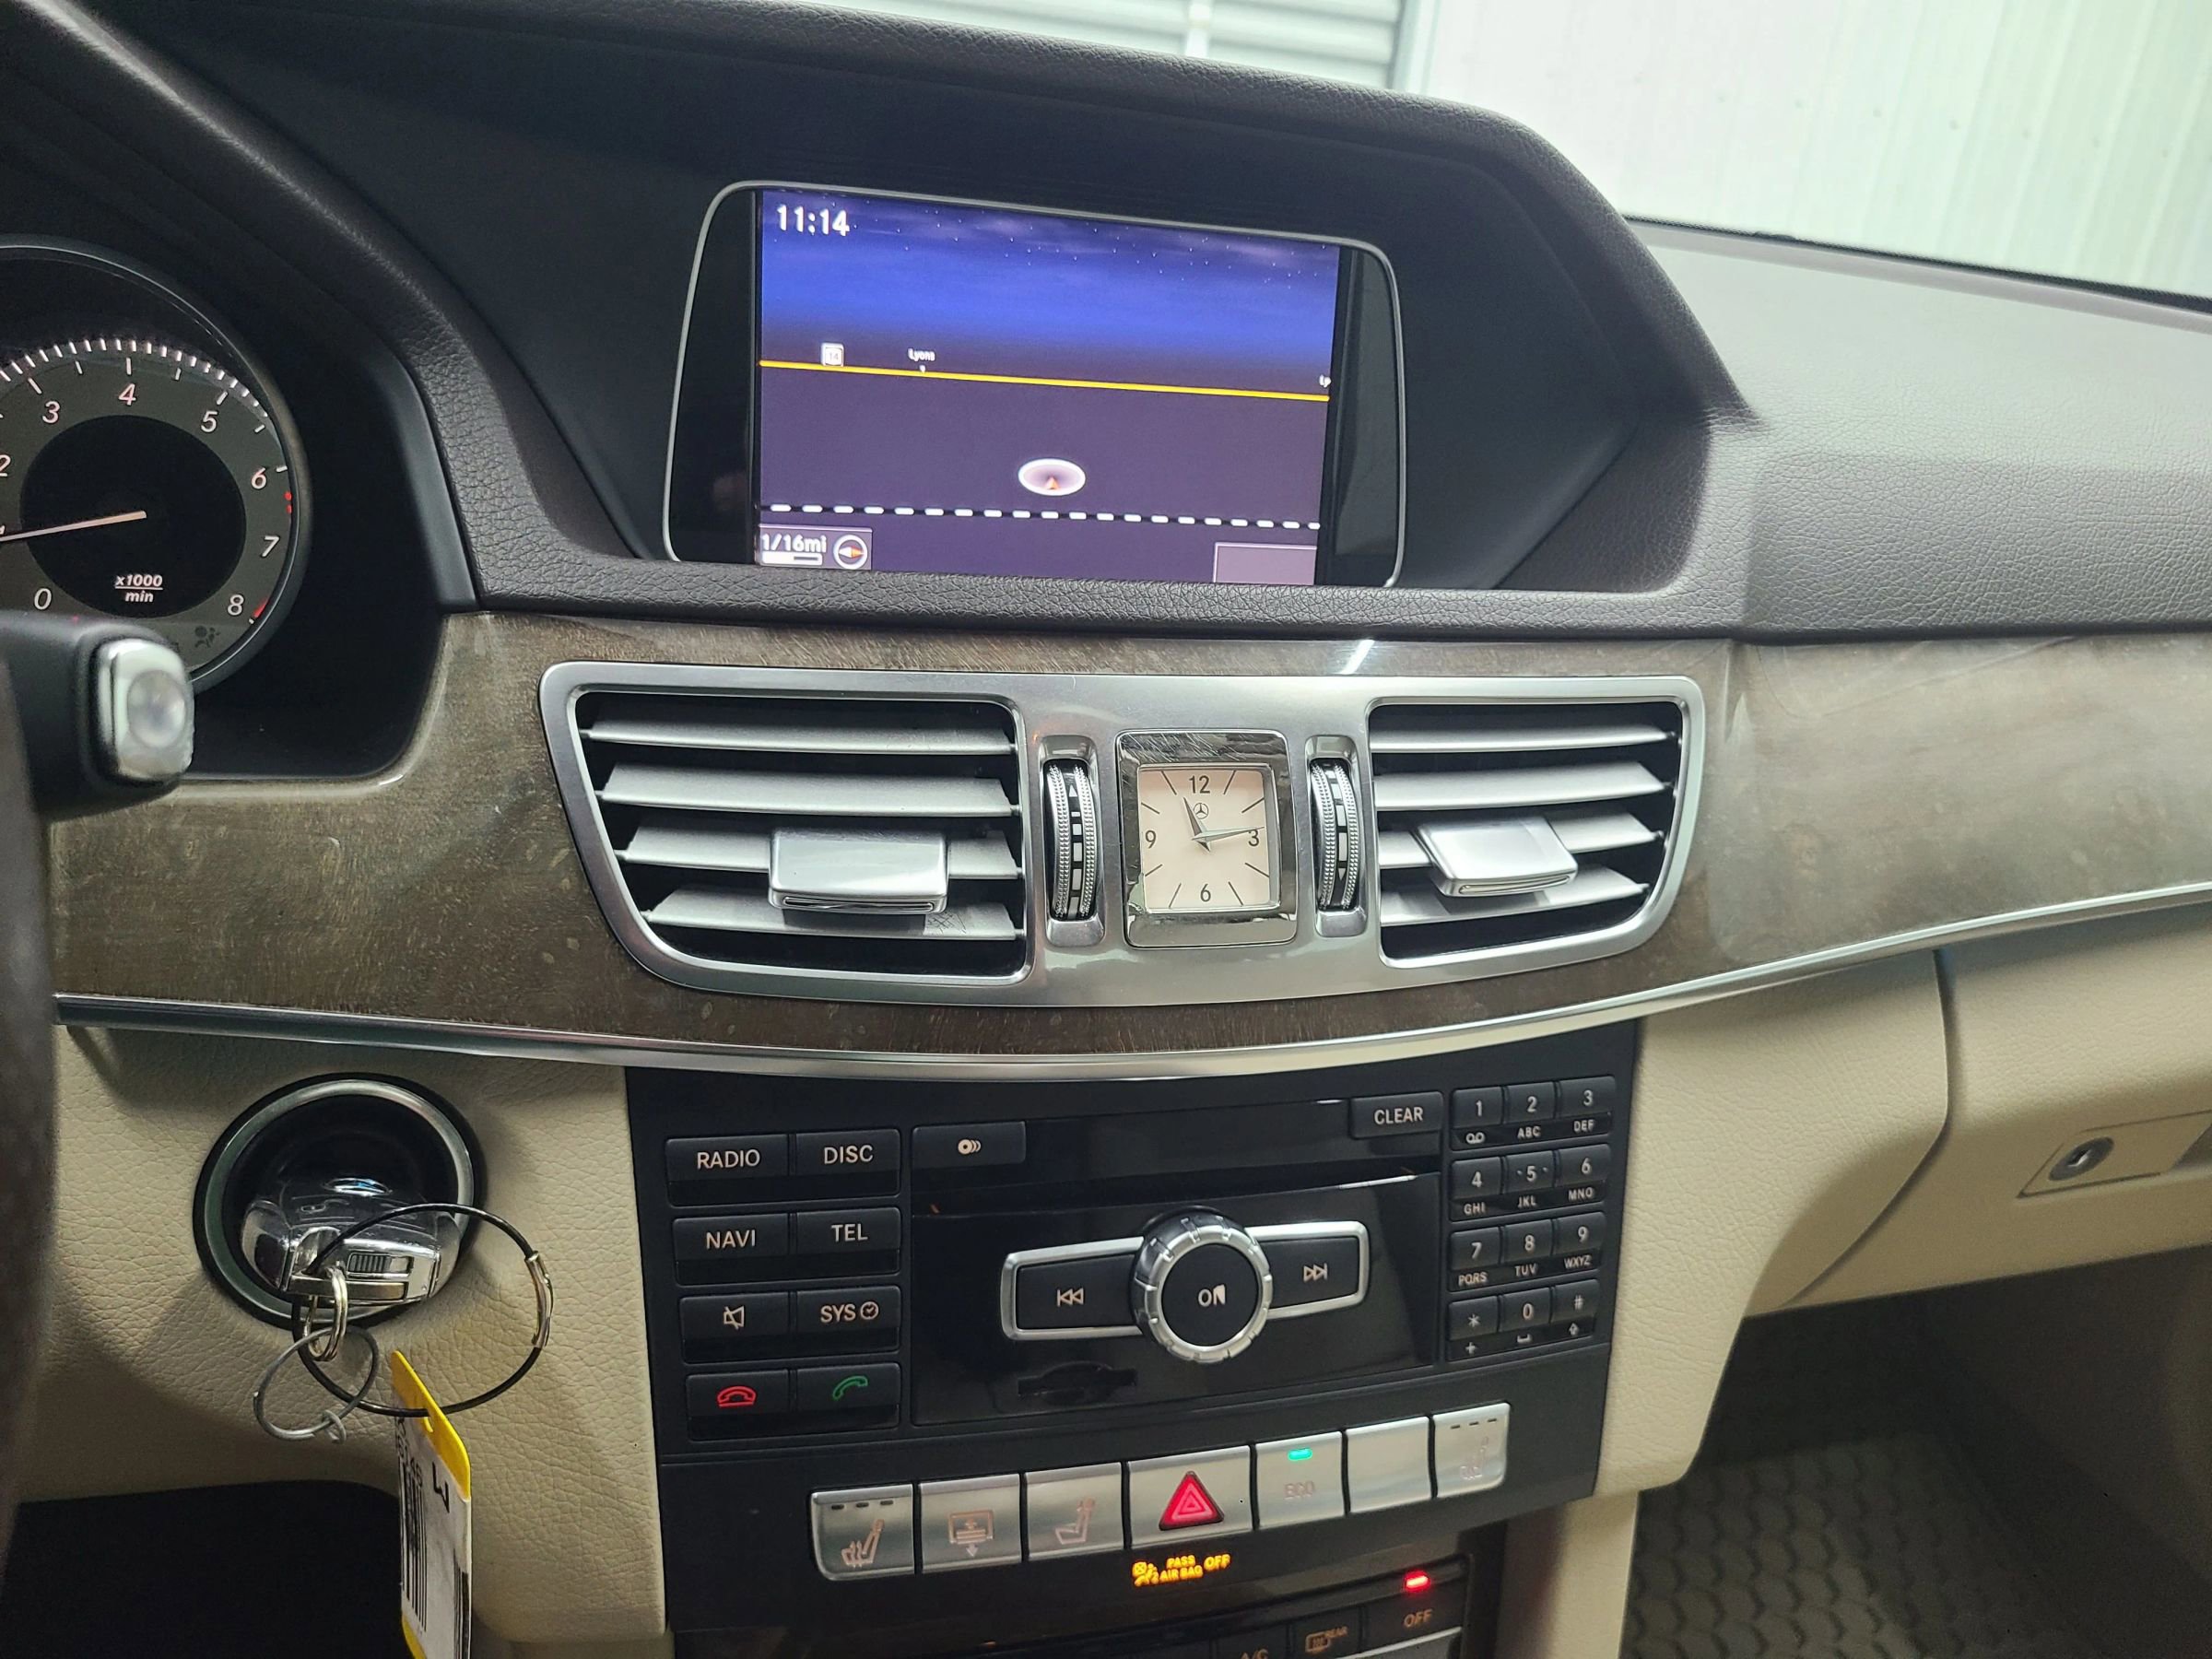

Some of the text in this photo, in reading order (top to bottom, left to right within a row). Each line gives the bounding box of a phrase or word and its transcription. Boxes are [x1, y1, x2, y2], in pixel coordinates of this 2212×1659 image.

[777, 204, 850, 237] 11:14
[119, 383, 136, 406] 4
[42, 401, 60, 423] 3
[201, 411, 218, 433] 5
[251, 467, 267, 489] 6
[261, 535, 280, 558] 7
[762, 534, 827, 553] 1/16mi
[115, 573, 163, 588] x1000
[34, 588, 52, 610] 0
[125, 589, 154, 603] min
[227, 594, 244, 616] 8
[1189, 775, 1210, 794] 12
[1145, 830, 1157, 848] 9
[1248, 830, 1260, 846] 3
[1200, 883, 1211, 902] 6
[1527, 1096, 1538, 1112] 2
[1583, 1089, 1594, 1106] 3
[1374, 1107, 1424, 1125] CLEAR
[1476, 1100, 1483, 1117] 1
[1517, 1126, 1542, 1139] ABC
[1573, 1120, 1594, 1133] DEF
[697, 1149, 760, 1170] RADIO
[824, 1145, 873, 1164] DISC
[1526, 1166, 1537, 1182] 5
[1582, 1158, 1592, 1174] 6
[1471, 1171, 1483, 1188] 4
[1518, 1195, 1537, 1208] JKL
[1568, 1187, 1594, 1201] MNO
[1464, 1202, 1486, 1215] GHI
[706, 1230, 757, 1249] NAVI
[831, 1224, 868, 1242] TEL
[1577, 1227, 1589, 1242] 9
[1471, 1242, 1482, 1259] 7
[1524, 1235, 1535, 1252] 8
[1514, 1264, 1538, 1277] TUV
[1564, 1255, 1593, 1269] WXYZ
[1458, 1272, 1488, 1287] PQRS
[820, 1304, 856, 1324] SYS
[1523, 1303, 1534, 1320] 0
[1166, 1554, 1230, 1571] PASS OFF
[1159, 1565, 1204, 1583] AIR BAG
[1404, 1609, 1433, 1628] OFF
